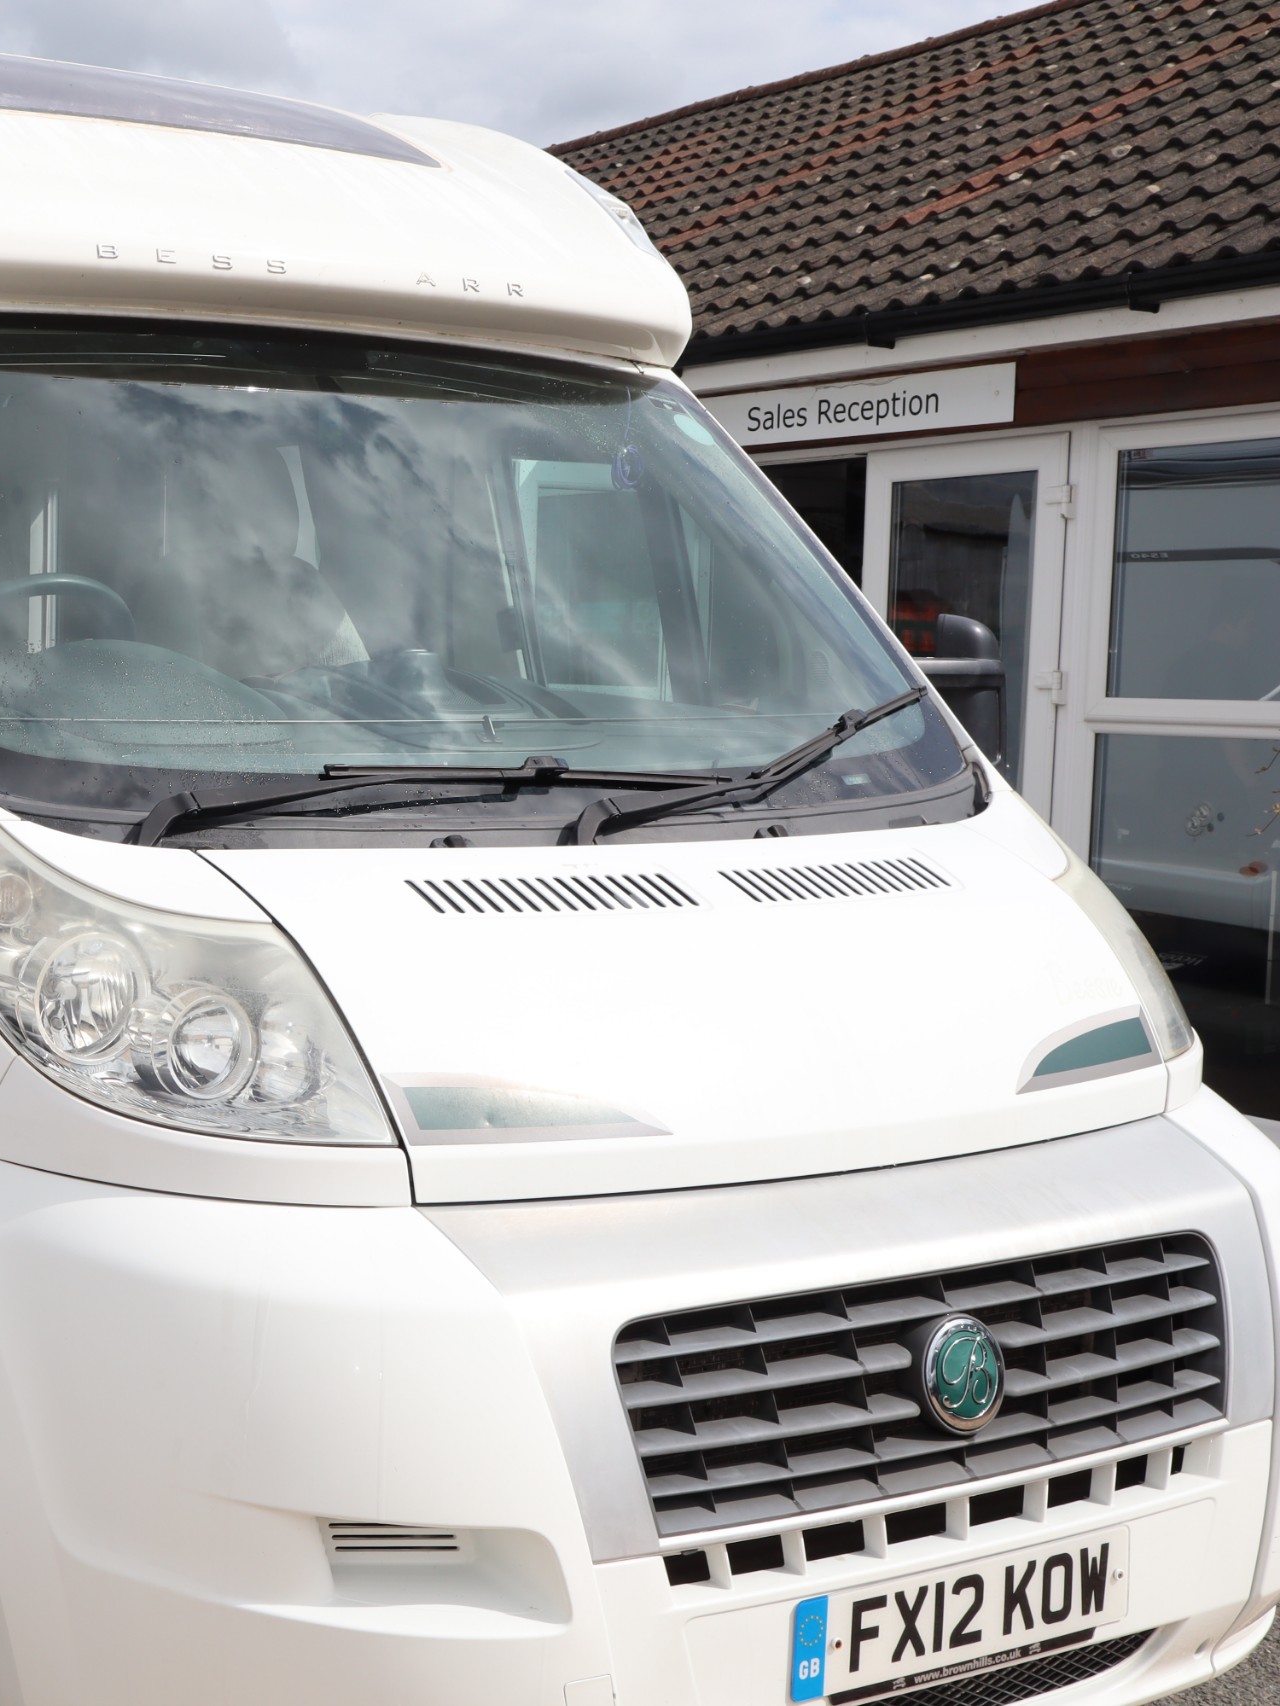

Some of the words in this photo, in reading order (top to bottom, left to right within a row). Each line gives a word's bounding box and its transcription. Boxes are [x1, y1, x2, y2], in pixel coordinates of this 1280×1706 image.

[746, 404, 808, 432] Sales
[817, 390, 940, 425] Reception
[848, 1573, 985, 1674] FX12
[1001, 1542, 1110, 1637] KOW
[798, 1657, 821, 1681] GB
[913, 1648, 1022, 1685] www.brownhills.co.uk
